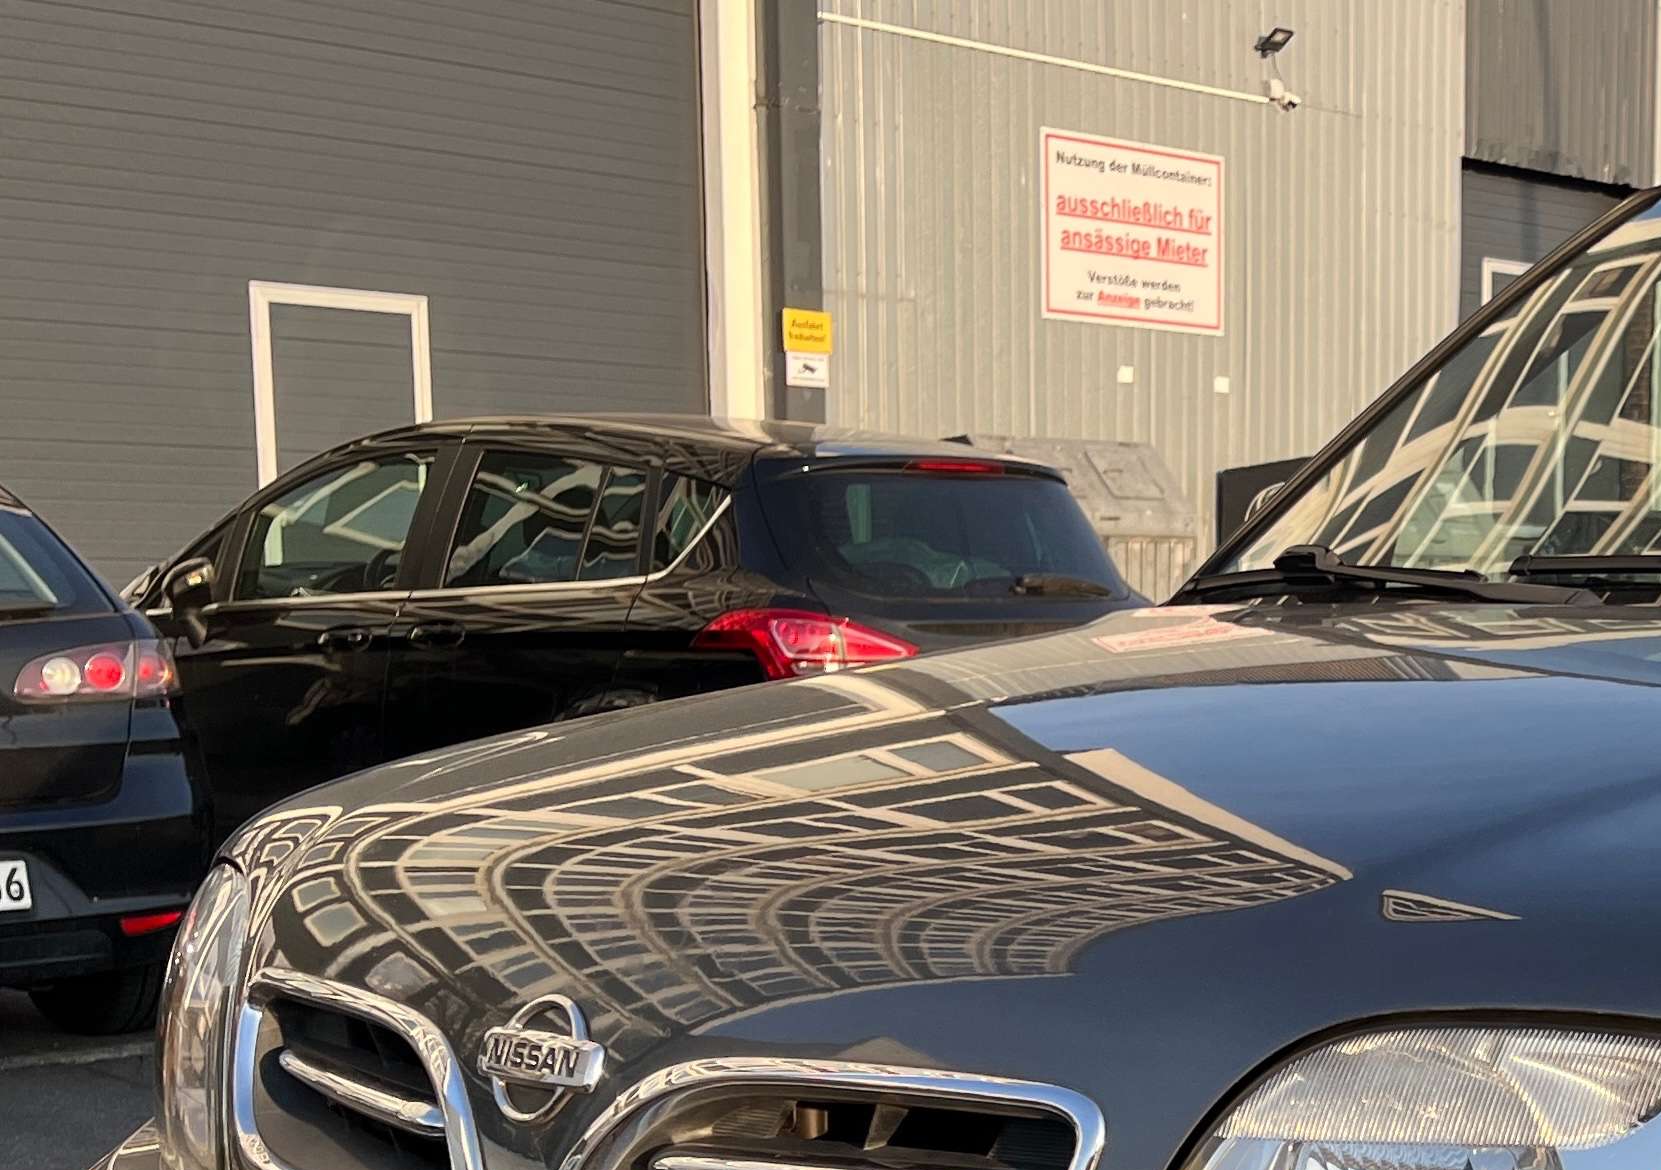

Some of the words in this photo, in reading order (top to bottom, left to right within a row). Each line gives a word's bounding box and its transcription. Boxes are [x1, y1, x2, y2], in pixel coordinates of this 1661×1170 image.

[1056, 150, 1105, 173] Nutzung
[1109, 160, 1128, 174] der
[1056, 194, 1184, 227] ausschließlich
[1188, 208, 1212, 232] für
[1060, 228, 1152, 259] ansässige
[1156, 236, 1209, 264] Mieter
[1076, 290, 1094, 300] zur
[1087, 270, 1138, 288] Verstöße
[1141, 279, 1181, 292] werden
[0, 867, 25, 901] 6
[486, 1037, 580, 1078] NISSAN
